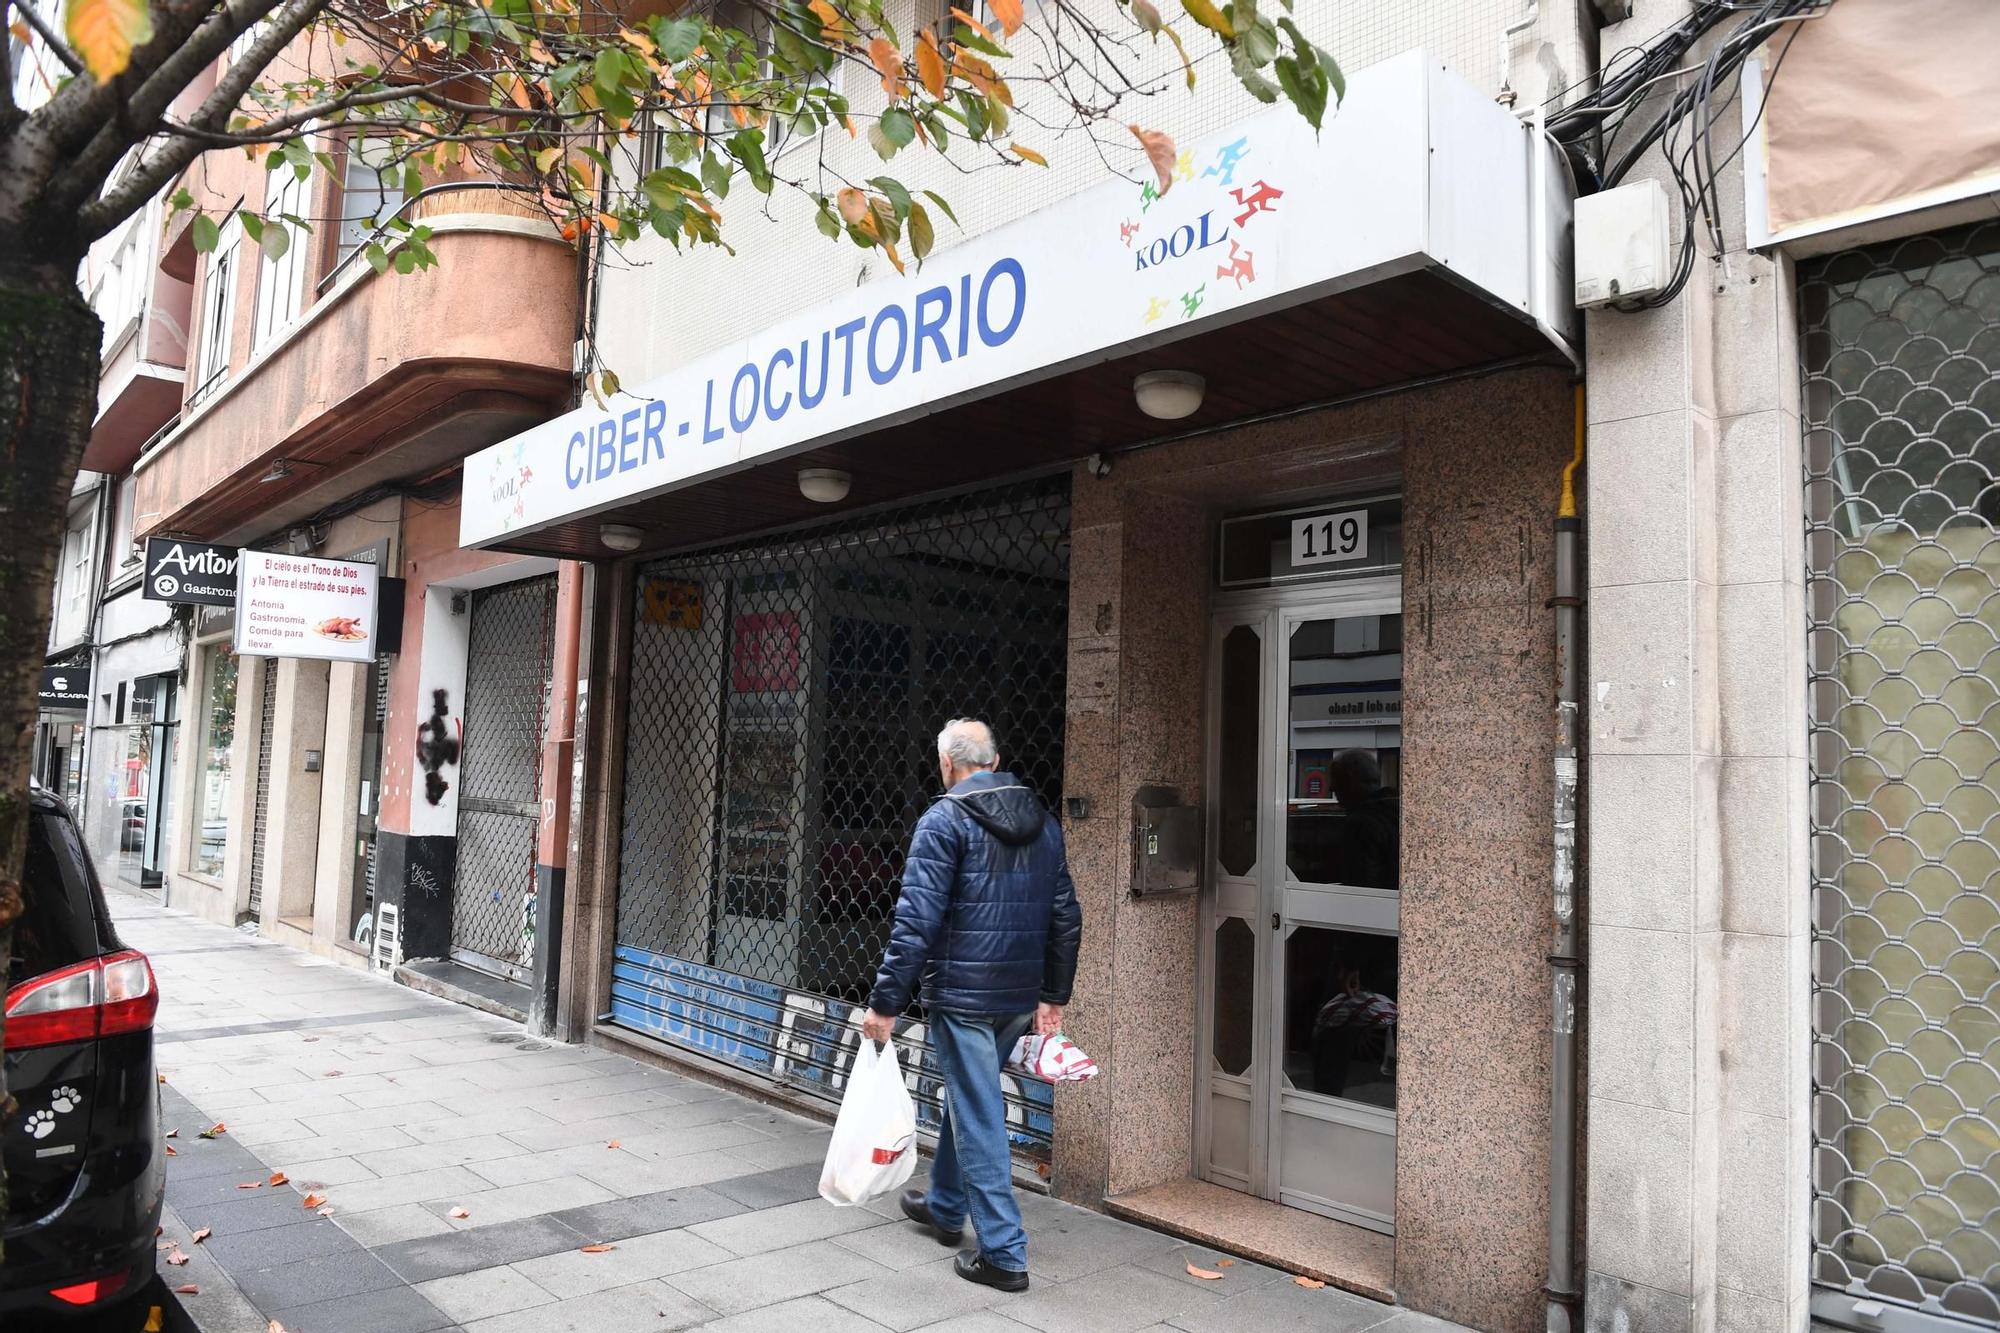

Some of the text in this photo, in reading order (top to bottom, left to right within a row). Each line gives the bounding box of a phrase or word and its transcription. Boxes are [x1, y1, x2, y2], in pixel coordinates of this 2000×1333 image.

[1134, 210, 1229, 273] KOOL
[565, 400, 666, 490] CIBER
[703, 257, 1026, 444] LOCUTORIO
[1302, 518, 1359, 558] 119
[265, 559, 358, 579] El cielo es el Trono de Dios
[252, 576, 258, 587] y
[259, 575, 266, 586] la
[268, 575, 289, 588] Tierra
[290, 578, 298, 589] el
[299, 579, 325, 592] estrado
[327, 582, 336, 593] de
[337, 584, 349, 594] sus
[250, 599, 284, 610] Antonia
[249, 625, 304, 639] Comida para
